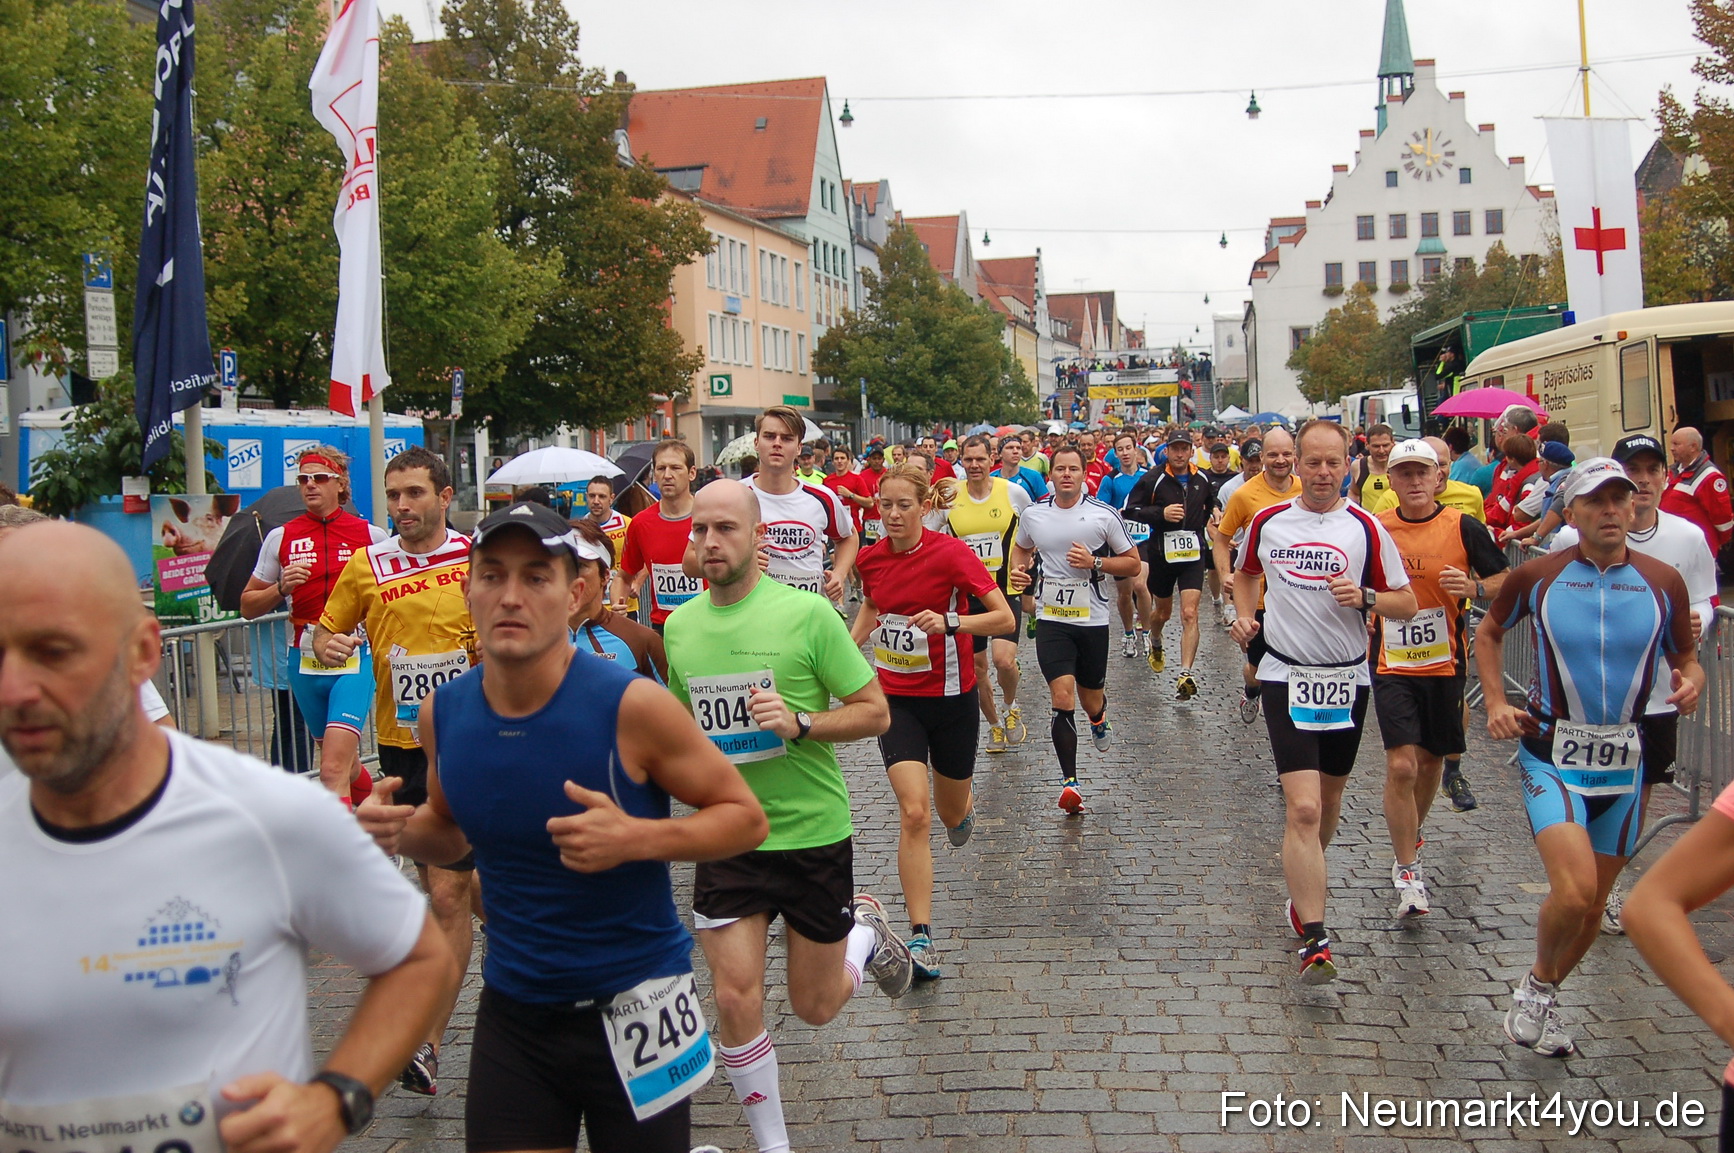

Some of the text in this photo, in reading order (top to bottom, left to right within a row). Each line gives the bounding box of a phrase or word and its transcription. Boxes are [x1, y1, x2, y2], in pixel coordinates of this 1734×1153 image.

[223, 355, 233, 382] P
[1543, 363, 1593, 391] Bayerisches
[713, 378, 728, 393] D
[1117, 387, 1148, 396] START
[1543, 393, 1567, 412] Rotes
[1626, 437, 1655, 448] THULE
[765, 527, 804, 537] RHART
[1171, 537, 1193, 550] 198
[1270, 549, 1333, 561] GERHART
[381, 567, 469, 605] MAX BÖ
[657, 576, 698, 593] 2048
[1278, 573, 1287, 584] Das
[1287, 580, 1318, 592] sportliche
[1055, 589, 1075, 605] 47
[880, 627, 914, 652] 473
[1398, 622, 1436, 646] 165
[886, 654, 910, 666] Ursula
[1406, 650, 1430, 659] Xaver
[392, 658, 455, 671] PARTL Neumarkt
[690, 682, 757, 694] PARTL Neumarkt
[1296, 681, 1350, 705] 3025
[698, 696, 754, 731] 304
[1314, 711, 1333, 720] Willi
[1557, 726, 1625, 740] PARTL Neumarkt
[715, 736, 759, 752] Norbert
[1561, 739, 1629, 767] 2191
[1581, 773, 1608, 785] Hans
[612, 1000, 649, 1020] ARTL
[624, 976, 700, 1069] 2481
[667, 1044, 710, 1085] Ronny
[58, 1112, 170, 1141] Neumarkt
